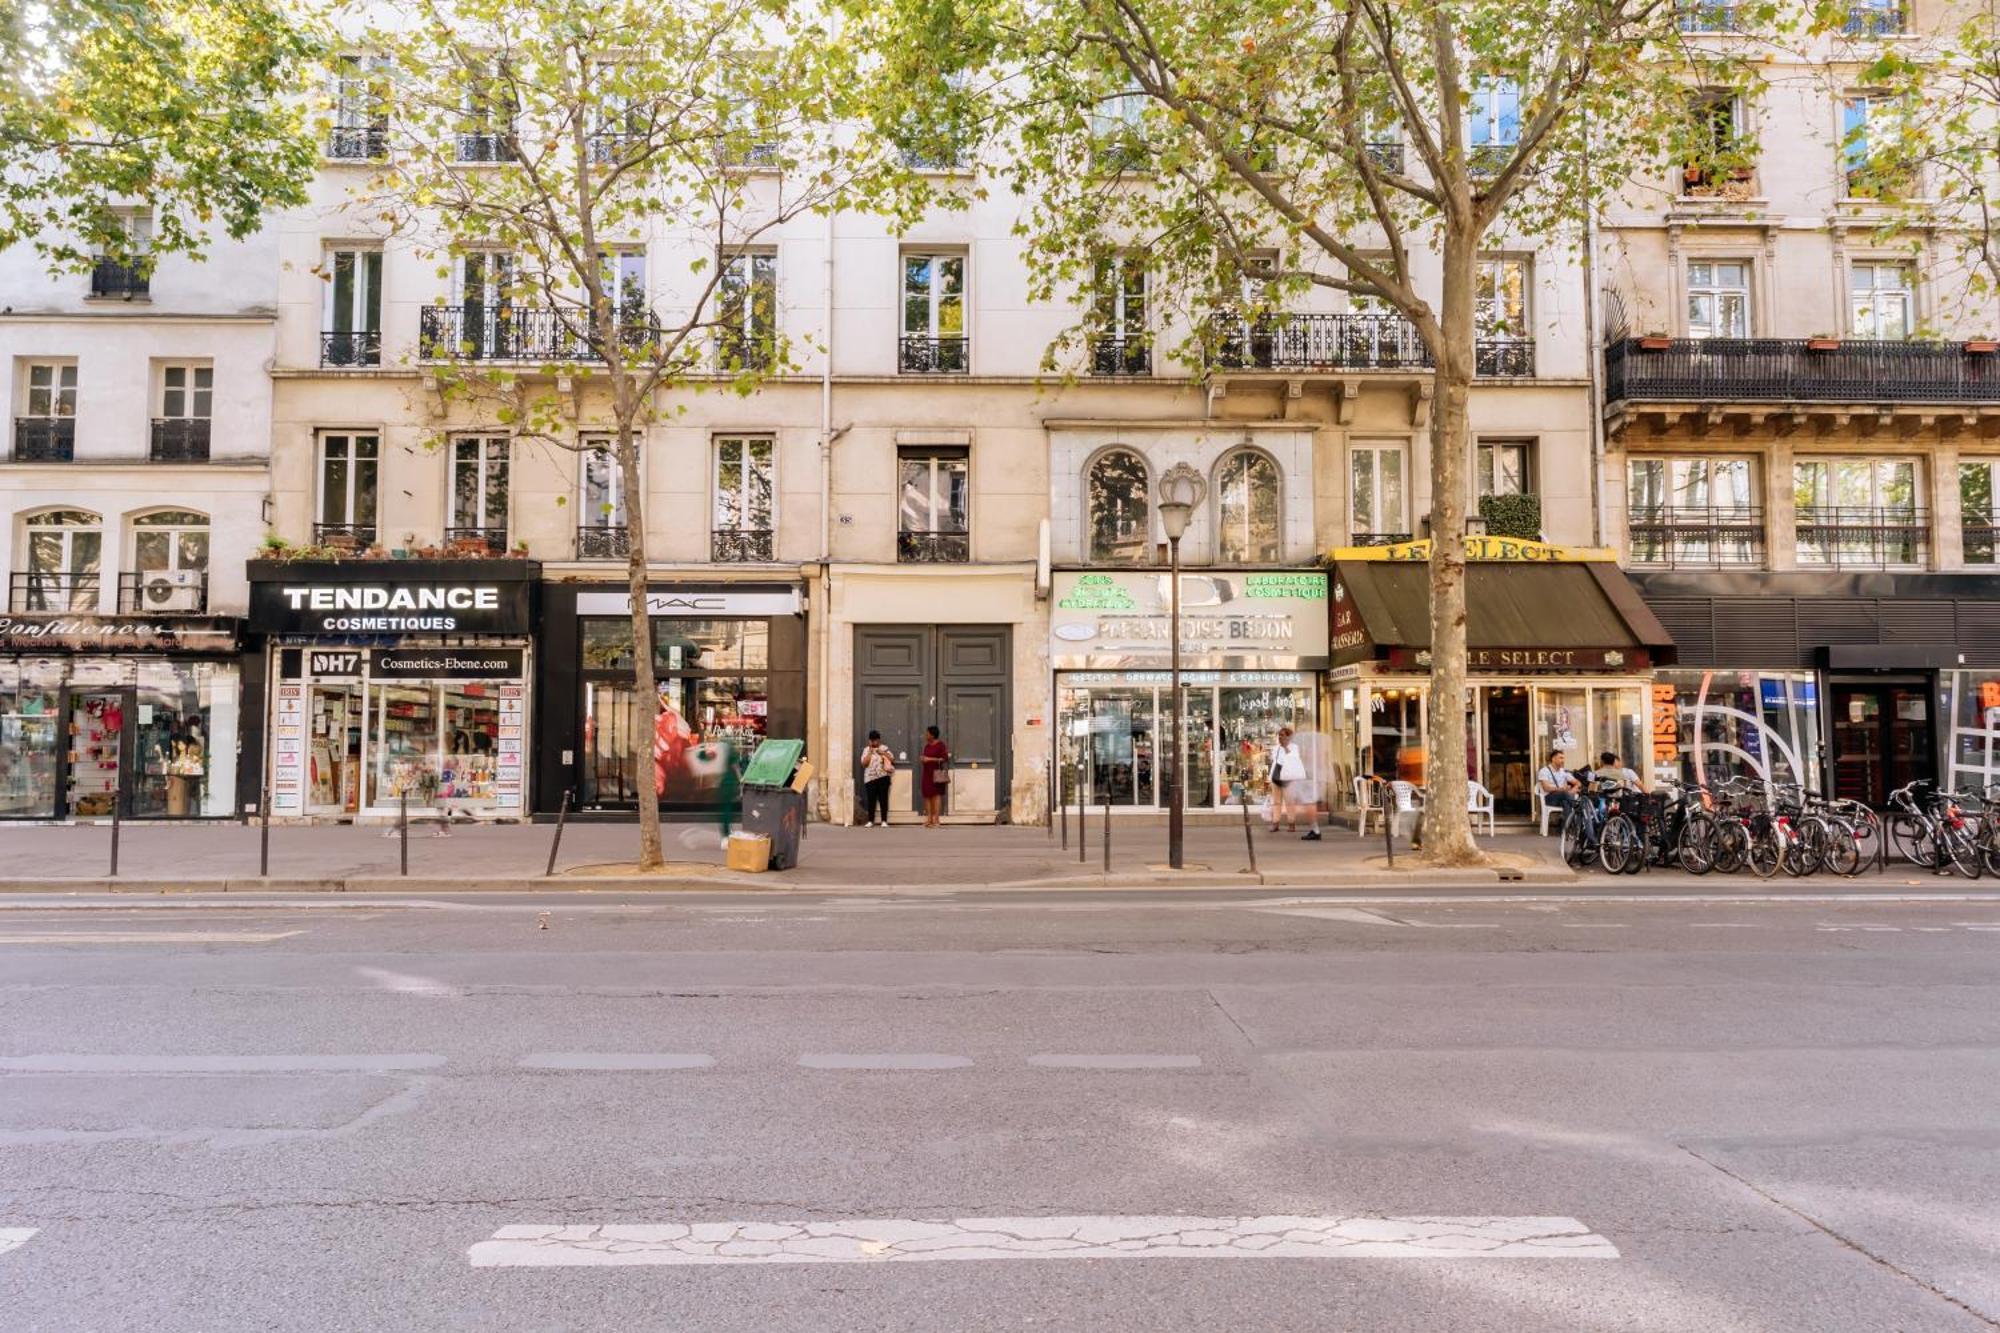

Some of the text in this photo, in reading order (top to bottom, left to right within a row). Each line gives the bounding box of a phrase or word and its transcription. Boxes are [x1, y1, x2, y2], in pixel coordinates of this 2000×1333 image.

[1387, 538, 1564, 561] LE ELECT
[283, 588, 499, 610] TENDANCE
[323, 618, 456, 630] COSMETIQUES
[1118, 621, 1223, 639] FRANOISE
[1230, 621, 1293, 638] BEDON
[314, 655, 357, 672] DH7
[380, 657, 508, 671] Cosmetics-Ebene.com
[1467, 652, 1575, 665] LE SELECT
[1652, 684, 1677, 761] BASIC
